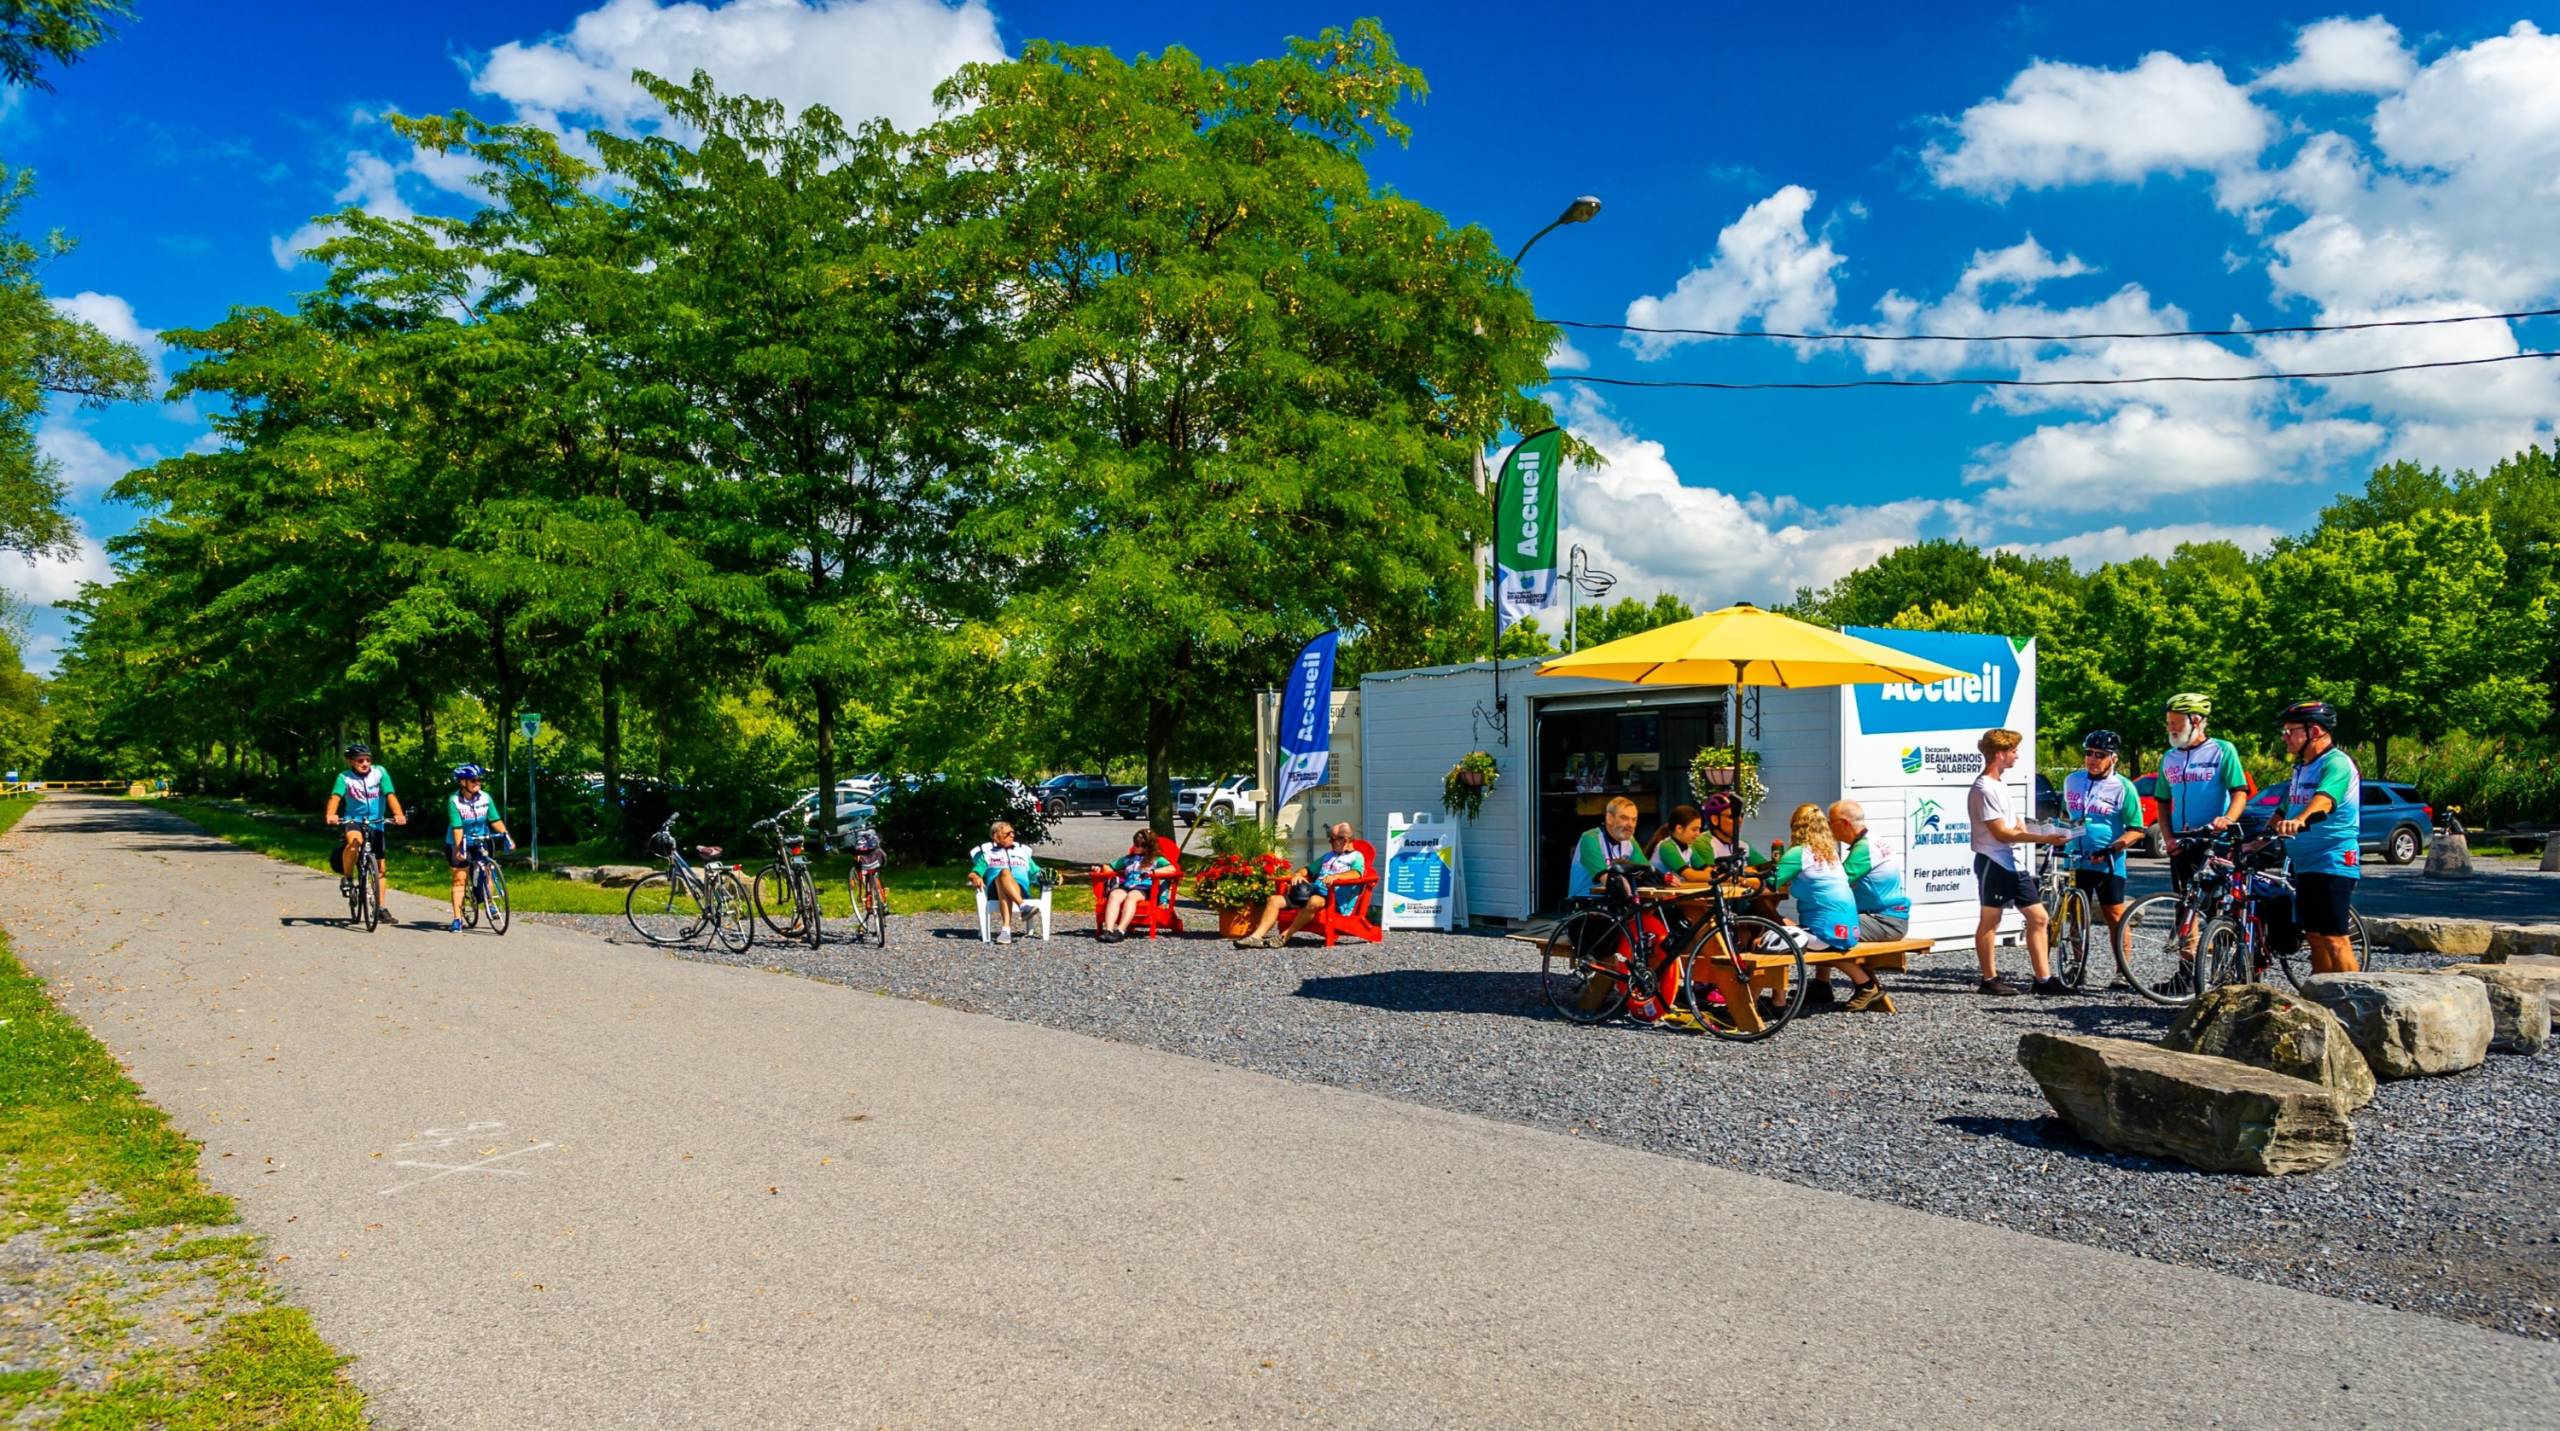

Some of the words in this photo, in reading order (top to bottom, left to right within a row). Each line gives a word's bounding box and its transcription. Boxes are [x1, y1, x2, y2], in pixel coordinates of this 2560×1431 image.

[1517, 452, 1540, 558] Accueil
[1297, 652, 1321, 742] Accueil
[1924, 753, 1982, 763] BEAUHARNOIS
[1936, 763, 1982, 774] SALABERRY
[1404, 839, 1440, 847] Accueil
[1914, 868, 1930, 878] Fier
[1932, 866, 1971, 879] partenaire
[1926, 881, 1960, 893] financier
